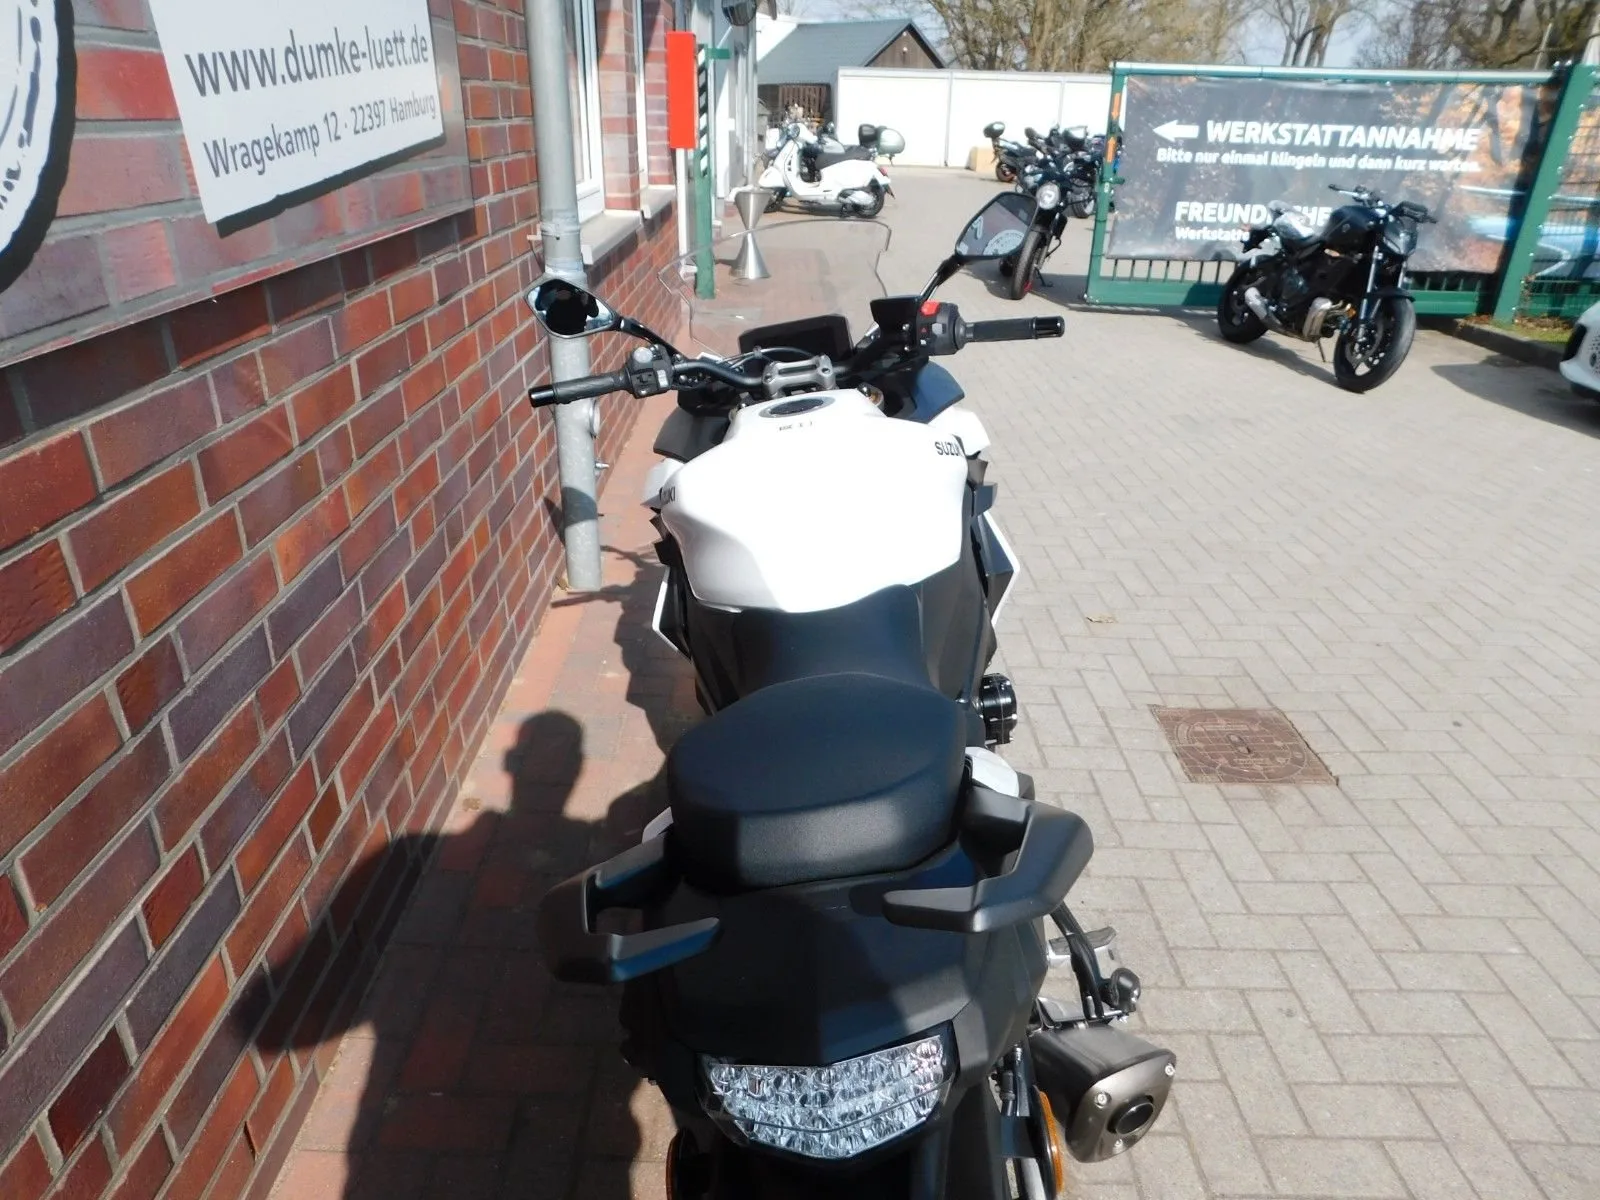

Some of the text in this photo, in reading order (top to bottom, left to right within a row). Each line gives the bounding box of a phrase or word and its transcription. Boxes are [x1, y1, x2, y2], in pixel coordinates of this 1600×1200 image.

[184, 23, 430, 98] www.dumke-luett.de
[202, 123, 321, 178] Wragekamp
[322, 111, 342, 144] 12
[350, 98, 387, 136] 22397
[389, 90, 437, 121] Hamburg
[1156, 147, 1194, 164] Bitte
[1194, 151, 1220, 164] nur
[1220, 149, 1268, 166] einmal
[1270, 151, 1327, 170] klingeln
[1328, 153, 1357, 169] und
[1357, 154, 1393, 171] dann
[1394, 155, 1427, 172] kurz
[1206, 119, 1482, 152] WERKSTATTANNAHME
